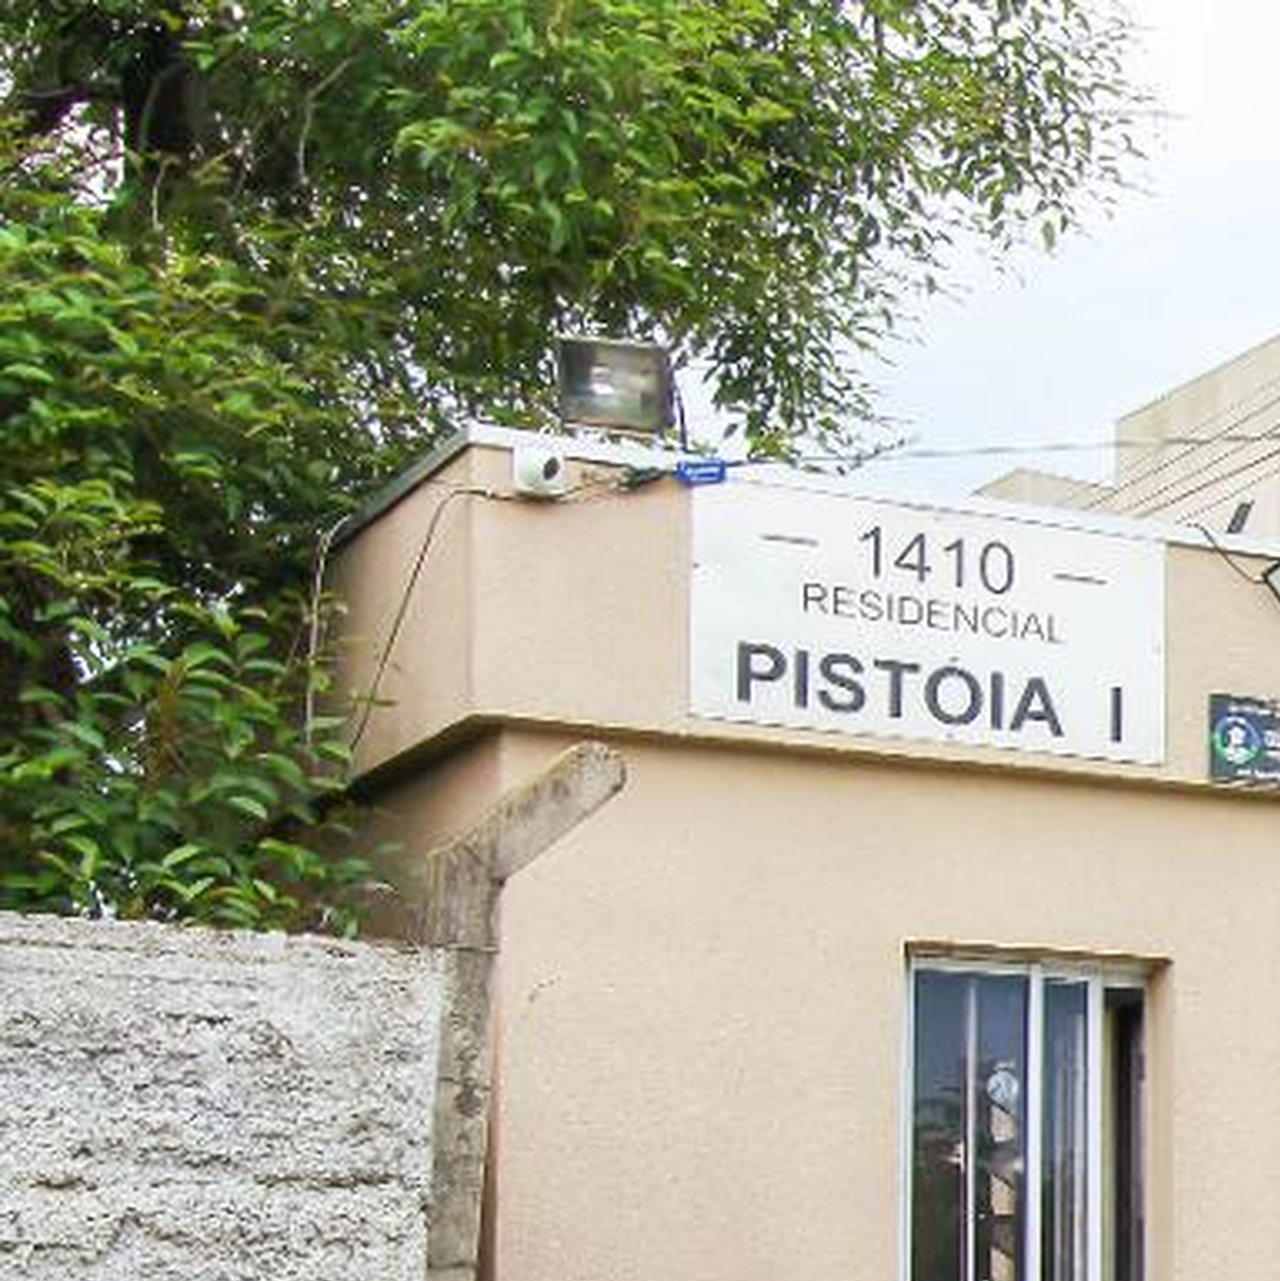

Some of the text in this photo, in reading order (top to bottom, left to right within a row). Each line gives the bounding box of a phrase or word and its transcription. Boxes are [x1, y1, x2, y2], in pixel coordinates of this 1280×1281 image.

[858, 525, 1016, 596] 1410
[802, 582, 1064, 644] RESIDENCIAL
[736, 640, 1124, 743] PISTÓIA I
